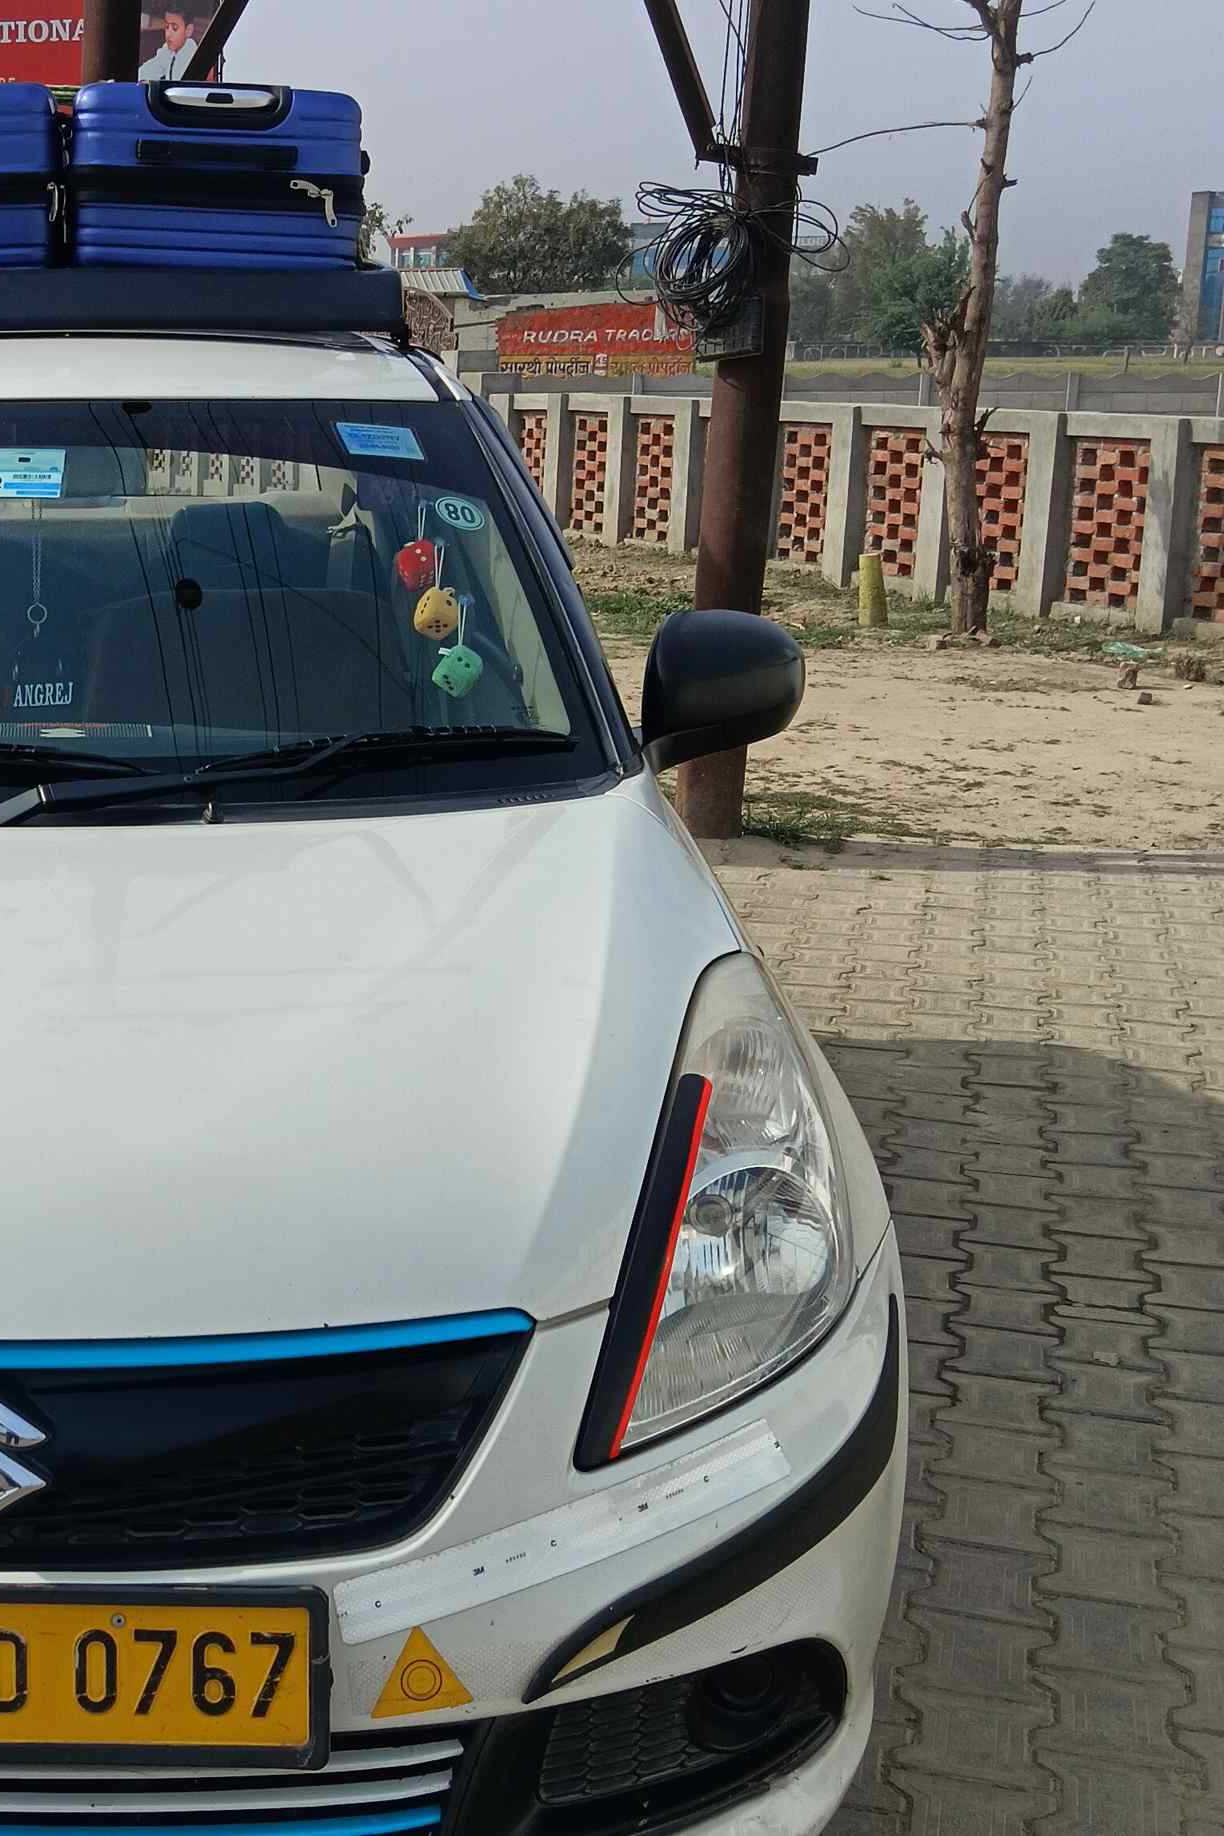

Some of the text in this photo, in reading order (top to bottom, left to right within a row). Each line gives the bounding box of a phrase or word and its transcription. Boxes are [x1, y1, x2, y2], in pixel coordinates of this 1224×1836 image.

[523, 330, 597, 344] RUDRA
[14, 681, 74, 708] ANGREJ
[74, 1628, 297, 1718] 0767
